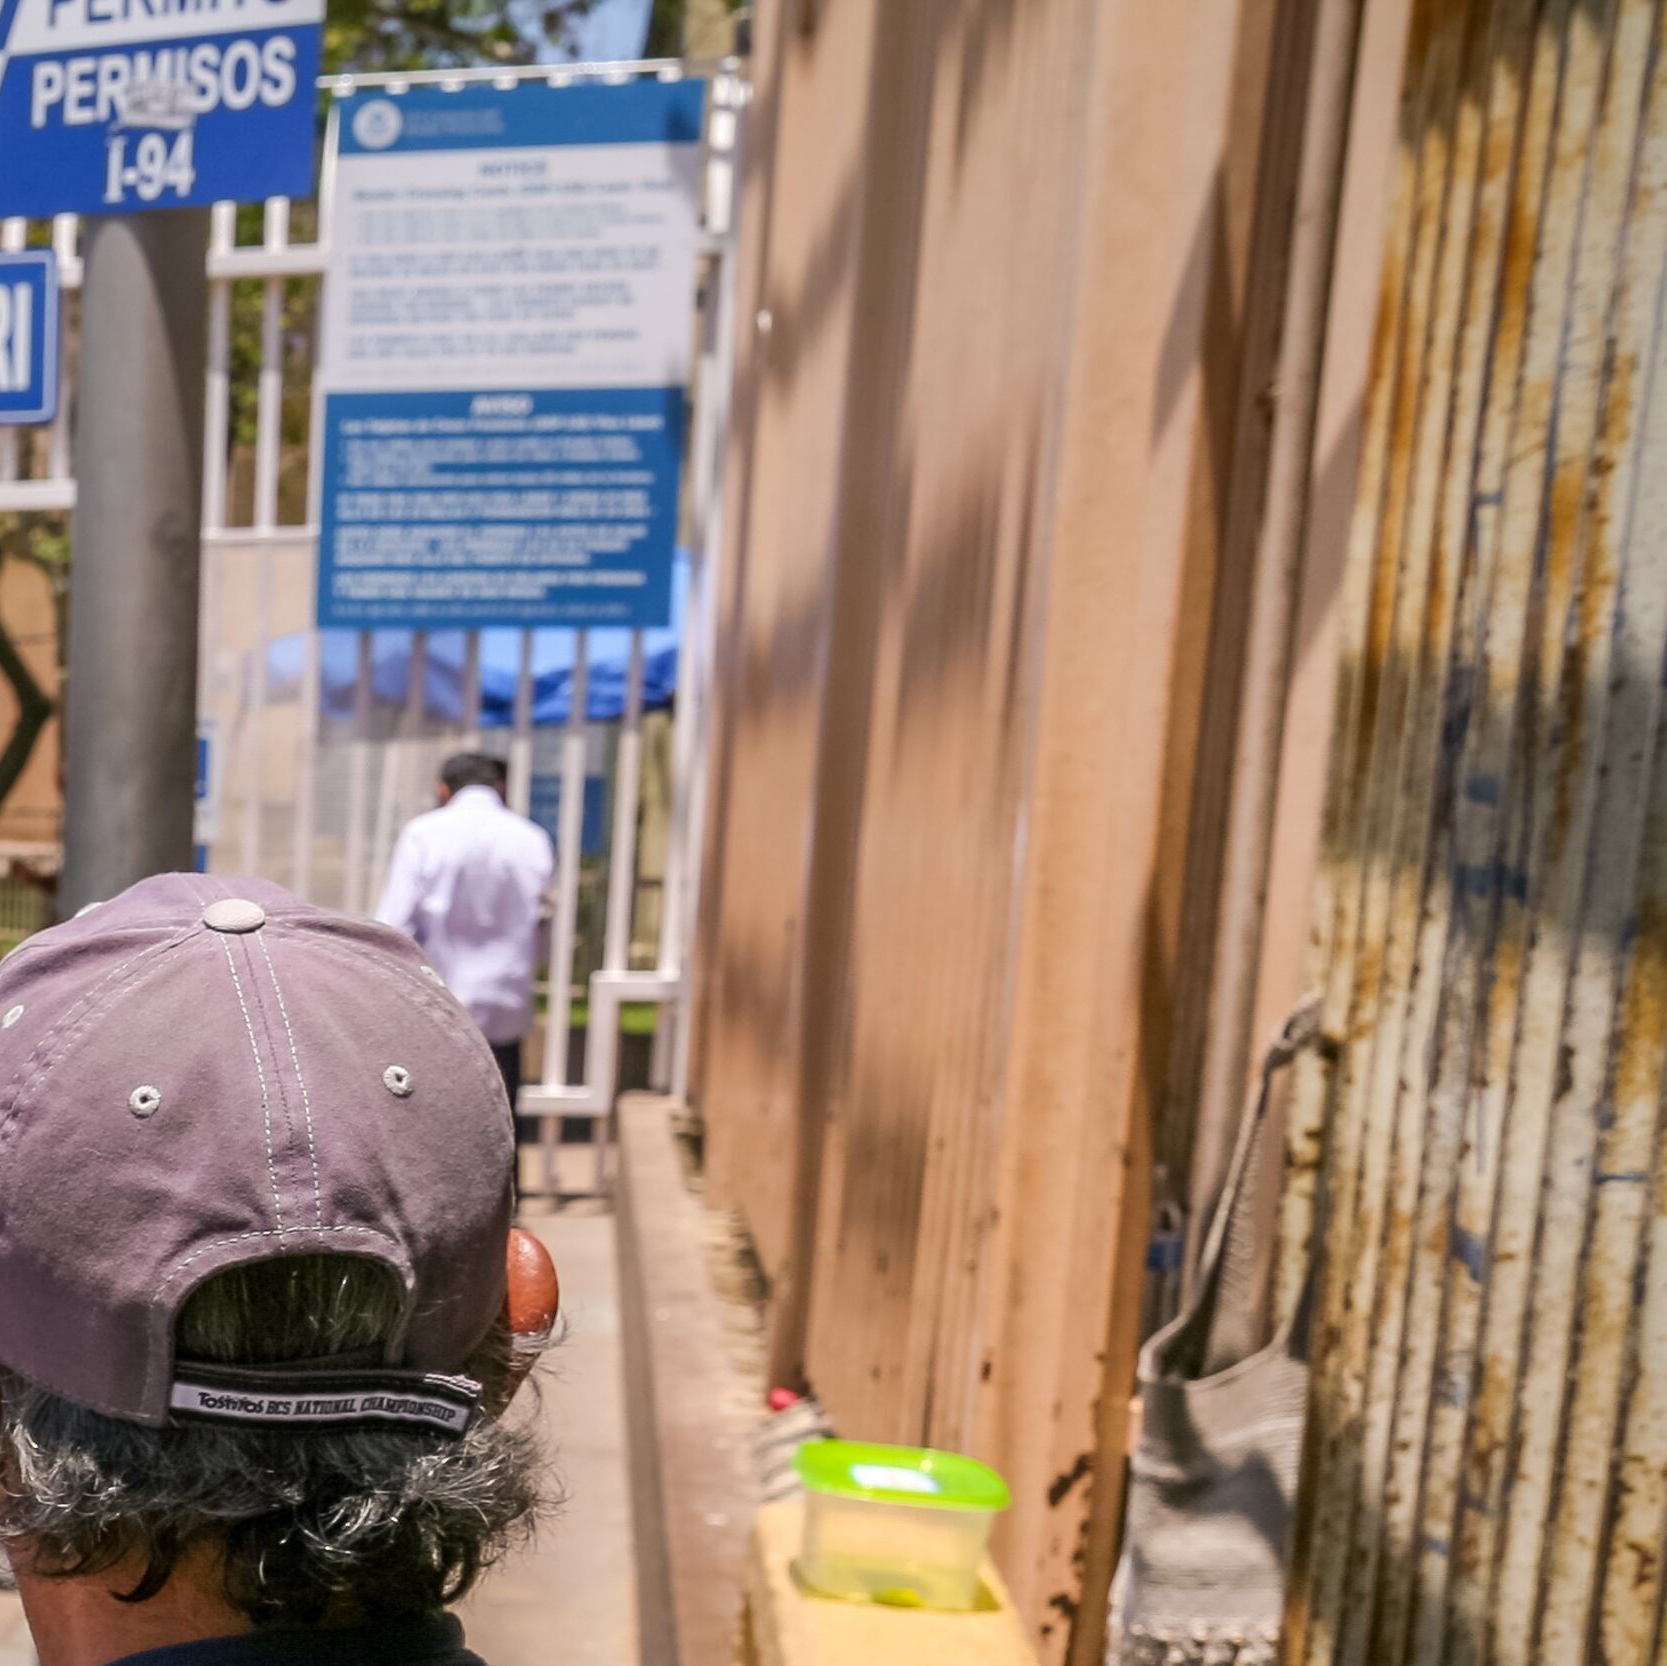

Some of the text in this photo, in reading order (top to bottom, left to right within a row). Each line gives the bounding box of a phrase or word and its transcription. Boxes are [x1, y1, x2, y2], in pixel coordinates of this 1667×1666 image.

[103, 132, 196, 203] I-94
[266, 1400, 291, 1415] BCS
[293, 1399, 356, 1415] NATIONAL
[360, 1397, 456, 1422] CHAMPIONSHIP
